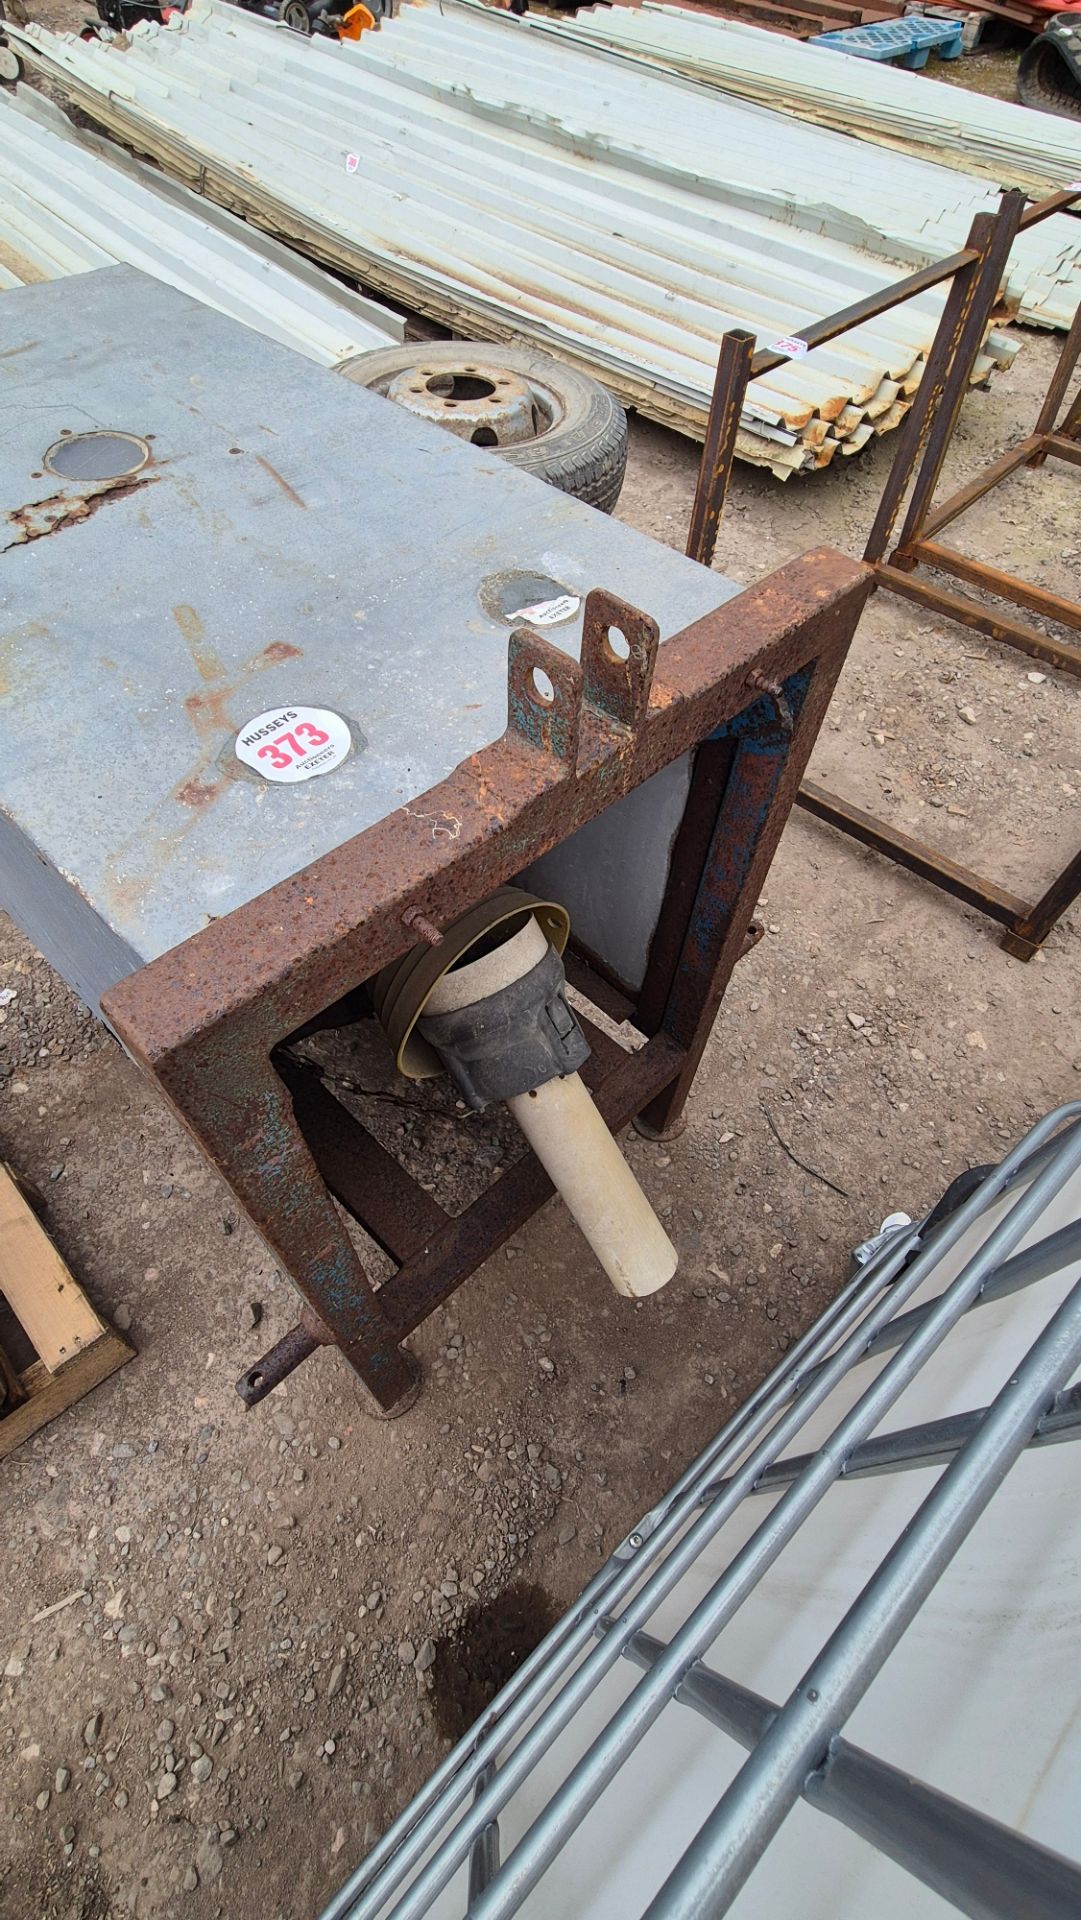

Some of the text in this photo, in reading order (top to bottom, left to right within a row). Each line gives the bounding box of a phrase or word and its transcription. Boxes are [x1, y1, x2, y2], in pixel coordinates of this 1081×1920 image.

[241, 710, 298, 747] HUSSEYS
[257, 722, 330, 769] 373
[295, 743, 335, 770] Auctioneers
[304, 750, 335, 770] EXETER
